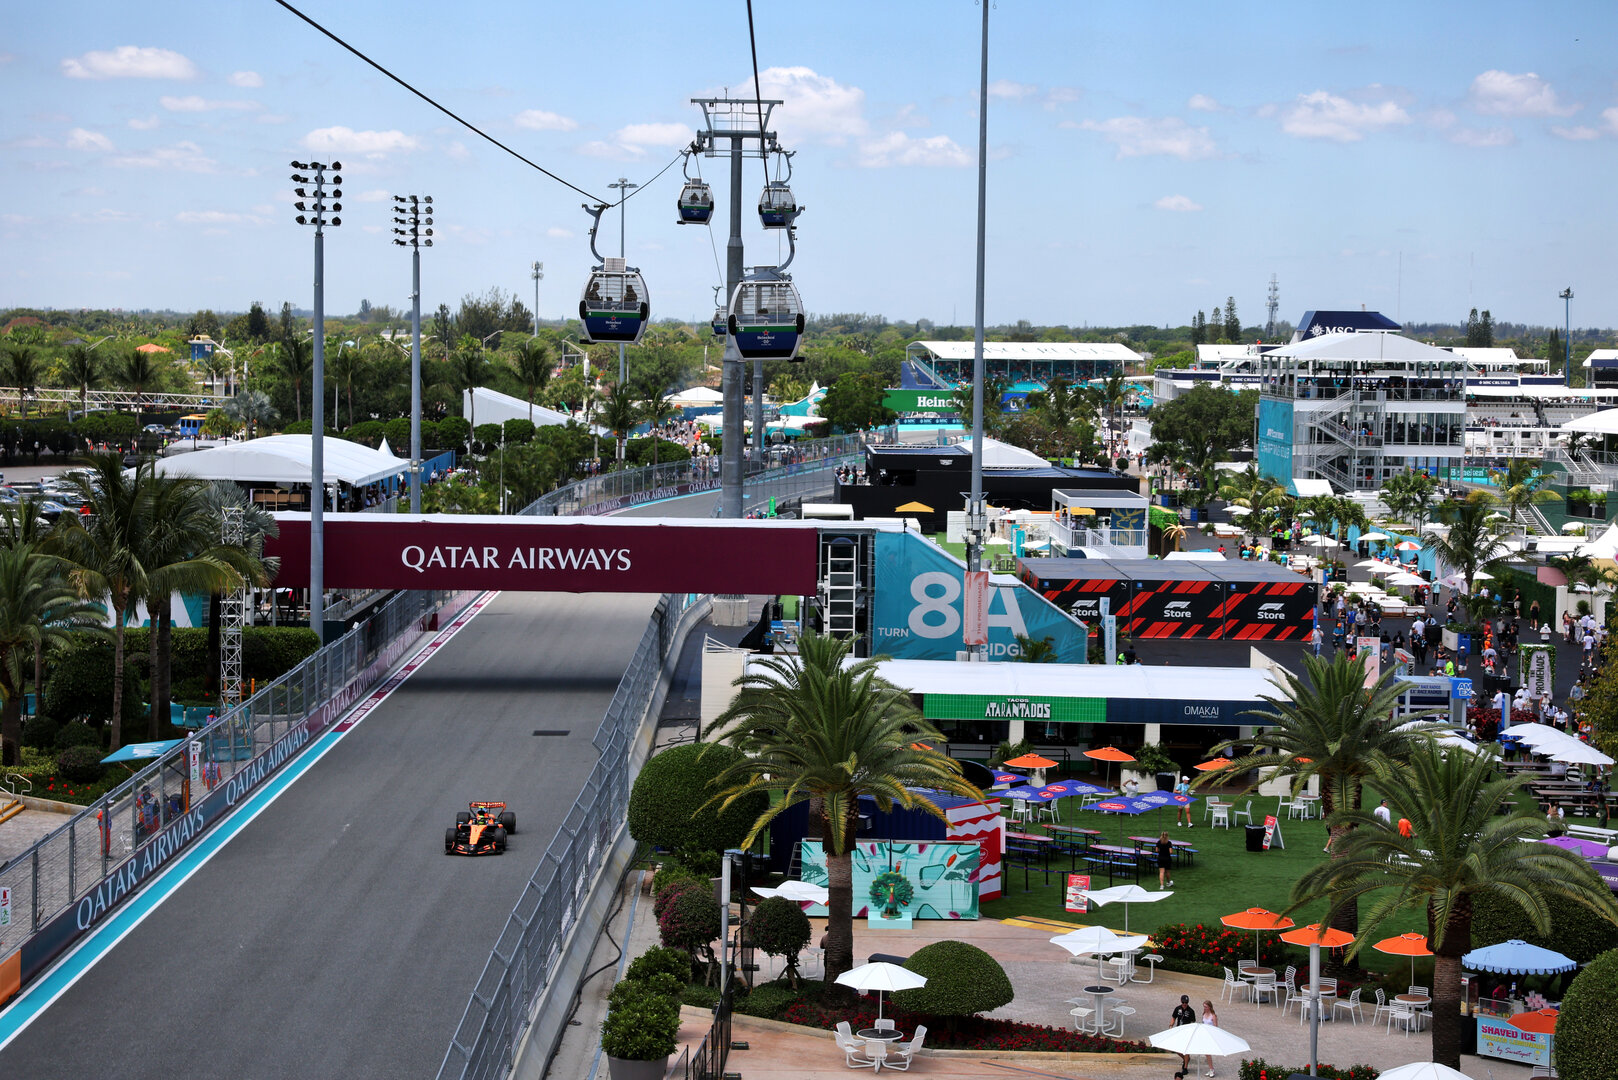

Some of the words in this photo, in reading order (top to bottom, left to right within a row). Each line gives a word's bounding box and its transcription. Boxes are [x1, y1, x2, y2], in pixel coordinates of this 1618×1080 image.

[1325, 326, 1353, 335] MSC
[689, 480, 711, 493] QATAR
[630, 491, 650, 504] QATAR
[651, 486, 678, 501] AIRWAYS
[401, 545, 500, 573] QATAR
[508, 546, 632, 571] AIRWAYS
[1071, 608, 1098, 617] Store
[1164, 610, 1192, 618] Store
[1257, 611, 1285, 620] Store
[878, 627, 909, 638] TURN
[1535, 655, 1545, 695] PROMENADE
[323, 687, 350, 725] QATAR
[350, 667, 378, 700] AIRWAYS
[985, 702, 1051, 718] ATARANTADOS
[1184, 705, 1219, 716] OMAKAI
[226, 763, 265, 805] QATAR
[267, 720, 309, 775] AIRWAYS
[77, 859, 138, 930] QATAR
[141, 804, 204, 878] AIRWAYS
[1481, 1025, 1518, 1039] SHAVED
[1521, 1032, 1536, 1042] ICE
[1482, 1034, 1508, 1044] FROZEN
[1509, 1038, 1546, 1051] LEMONADE
